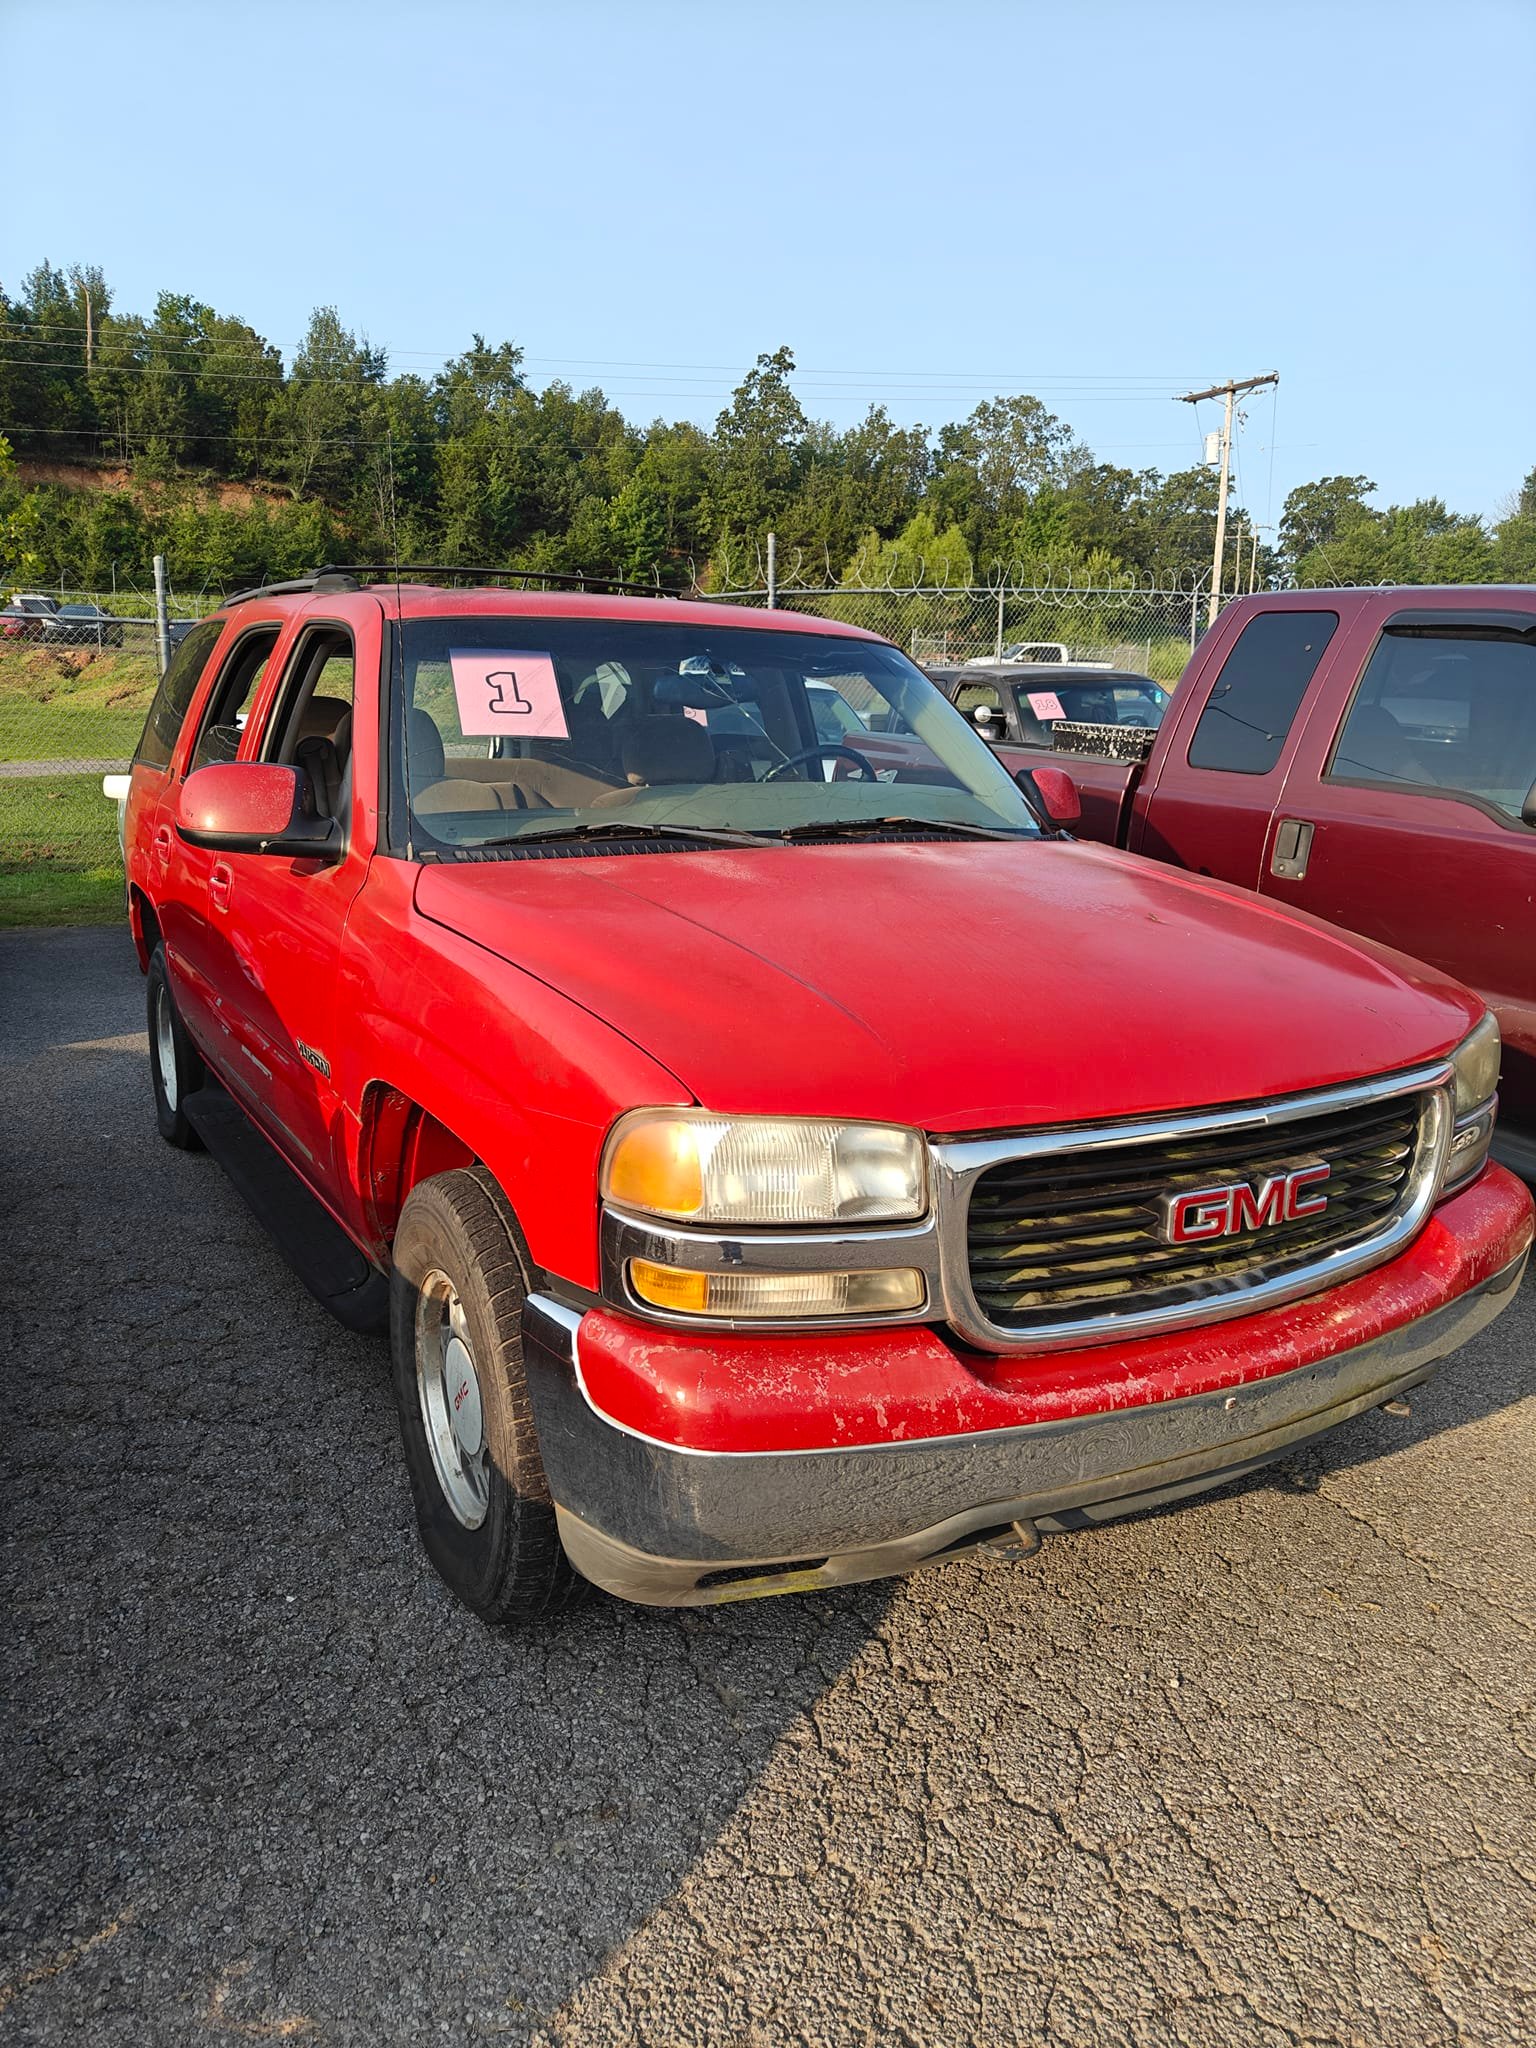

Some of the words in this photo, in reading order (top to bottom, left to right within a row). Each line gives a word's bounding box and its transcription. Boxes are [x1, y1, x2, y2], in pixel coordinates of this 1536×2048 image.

[485, 671, 532, 714] 1
[1035, 699, 1058, 710] 18
[1167, 1163, 1331, 1244] GMC
[454, 1380, 470, 1411] GMC
